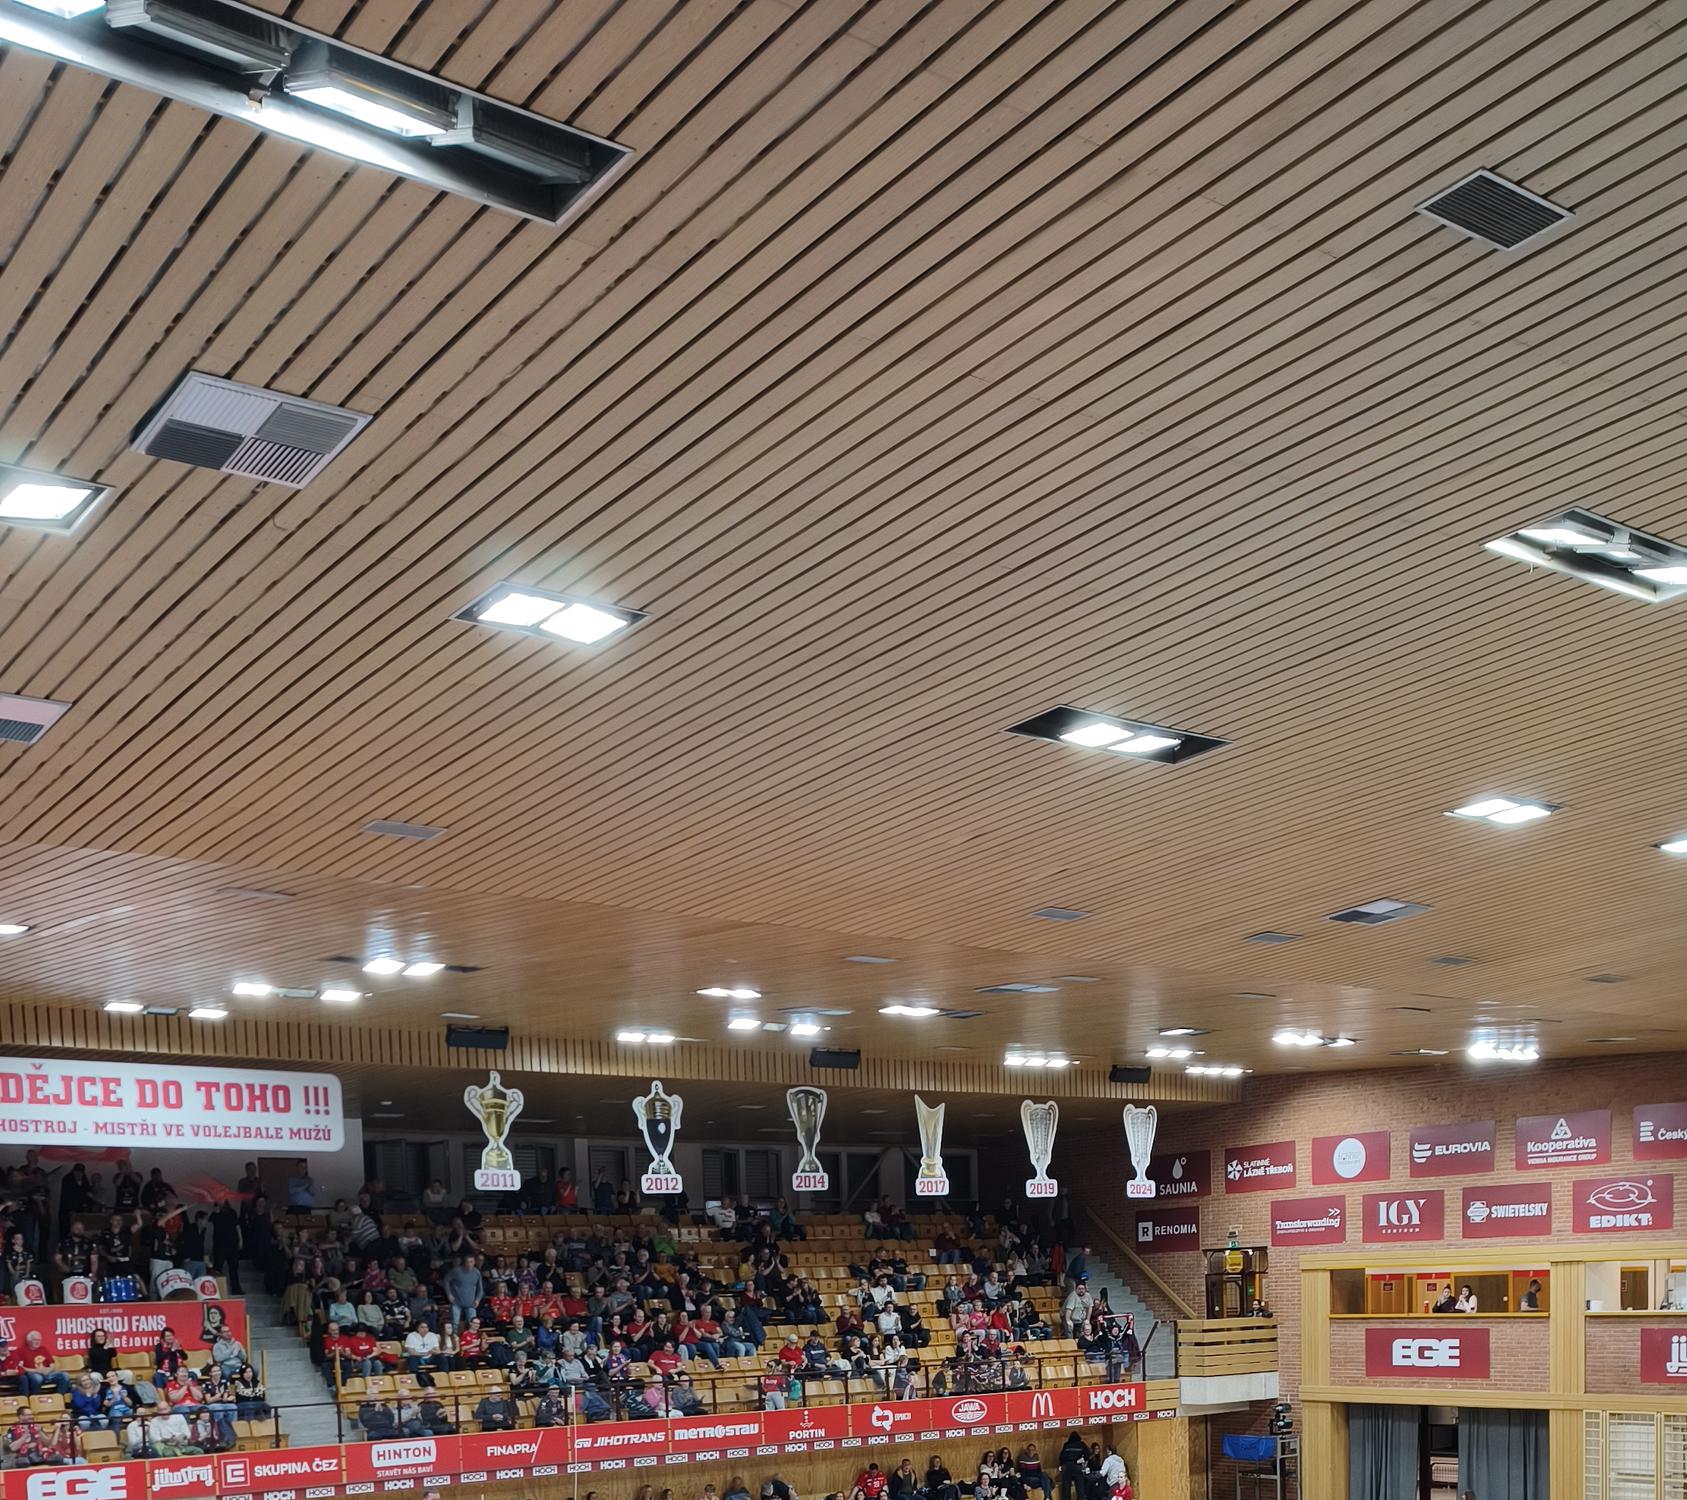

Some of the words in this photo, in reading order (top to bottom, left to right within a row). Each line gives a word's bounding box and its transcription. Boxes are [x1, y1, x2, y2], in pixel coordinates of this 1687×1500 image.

[0, 1063, 123, 1108] DĚJCE
[135, 1078, 183, 1109] DO
[195, 1081, 292, 1114] TOHO
[93, 1118, 157, 1137] MISTŘI
[163, 1123, 185, 1137] VE
[190, 1124, 284, 1140] VOLEJBALE
[1434, 1141, 1491, 1157] EUROVIA
[1527, 1136, 1597, 1153] Kooperativa
[479, 1173, 516, 1188] 2011
[645, 1177, 680, 1192] 2012
[795, 1175, 826, 1189] 2014
[918, 1180, 946, 1194] 2017
[1159, 1181, 1198, 1196] SAUNIA
[1029, 1183, 1055, 1195] 2019
[1130, 1183, 1153, 1195] 2024
[1378, 1199, 1428, 1227] IGY
[1491, 1203, 1549, 1219] SWIETELSKY
[1589, 1213, 1651, 1229] EDIKT
[1154, 1224, 1198, 1236] RENOMIA
[55, 1315, 129, 1335] JIHOSTROJ
[131, 1315, 167, 1332] FANS
[56, 1336, 92, 1350] ČESK
[1392, 1338, 1460, 1367] EGE
[958, 1402, 981, 1412] JAWA
[1089, 1388, 1136, 1410] HOCH
[593, 1432, 666, 1448] JIHOTRANS
[788, 1428, 825, 1440] PORTIN
[376, 1446, 432, 1461] HINTON
[254, 1461, 311, 1477] SKUPINA
[312, 1457, 339, 1472] ČEZ
[308, 1488, 333, 1497] HOCH
[348, 1484, 372, 1492] HOCH
[384, 1479, 414, 1491] HOCH
[425, 1476, 449, 1485] HOCH
[463, 1473, 486, 1481] HOCH
[496, 1468, 524, 1480] HOCH
[534, 1466, 556, 1474] HOCH
[569, 1463, 590, 1472] HOCH
[600, 1459, 626, 1470] HOCH
[635, 1457, 656, 1466] HOCH
[666, 1454, 687, 1462] HOCH
[696, 1451, 720, 1461] HOCH
[729, 1449, 748, 1457] HOCH
[758, 1446, 777, 1454] HOCH
[785, 1443, 807, 1453] HOCH
[815, 1441, 833, 1449] HOCH
[843, 1438, 860, 1446] HOCH
[868, 1435, 889, 1445] HOCH
[896, 1433, 914, 1441] HOCH
[922, 1431, 939, 1439] HOCH
[945, 1428, 965, 1438] HOCH
